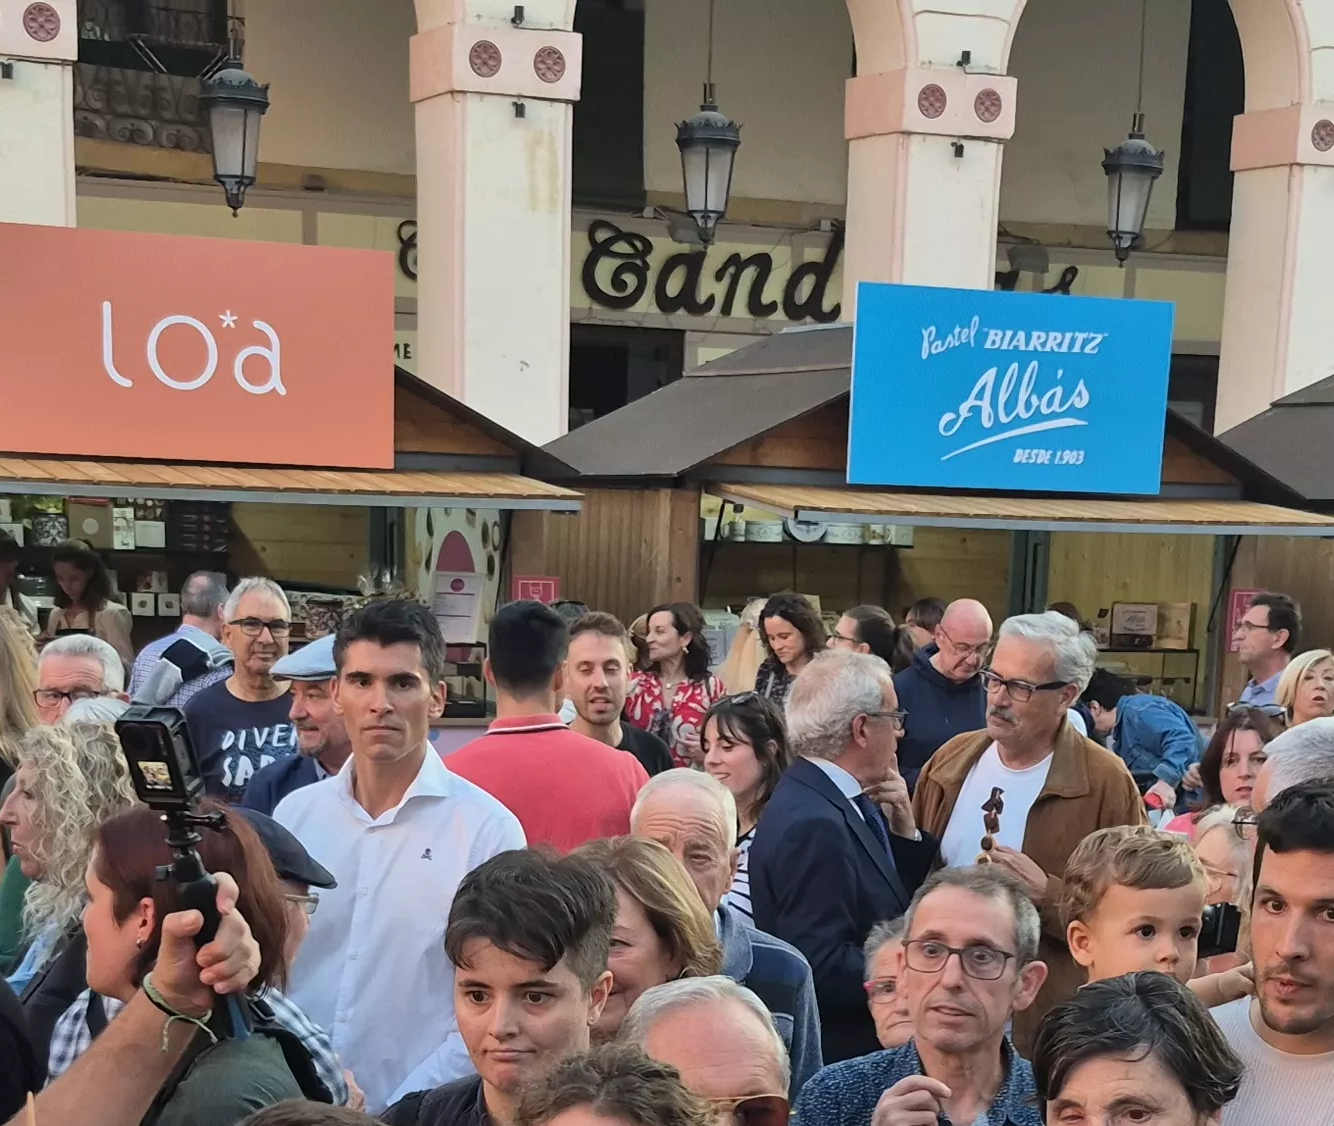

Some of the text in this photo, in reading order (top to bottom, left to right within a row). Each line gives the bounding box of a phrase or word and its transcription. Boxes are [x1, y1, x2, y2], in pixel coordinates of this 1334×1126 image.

[921, 314, 980, 360] Pastel
[938, 359, 1091, 437] Albás
[1012, 448, 1086, 465] DESDE 1.903
